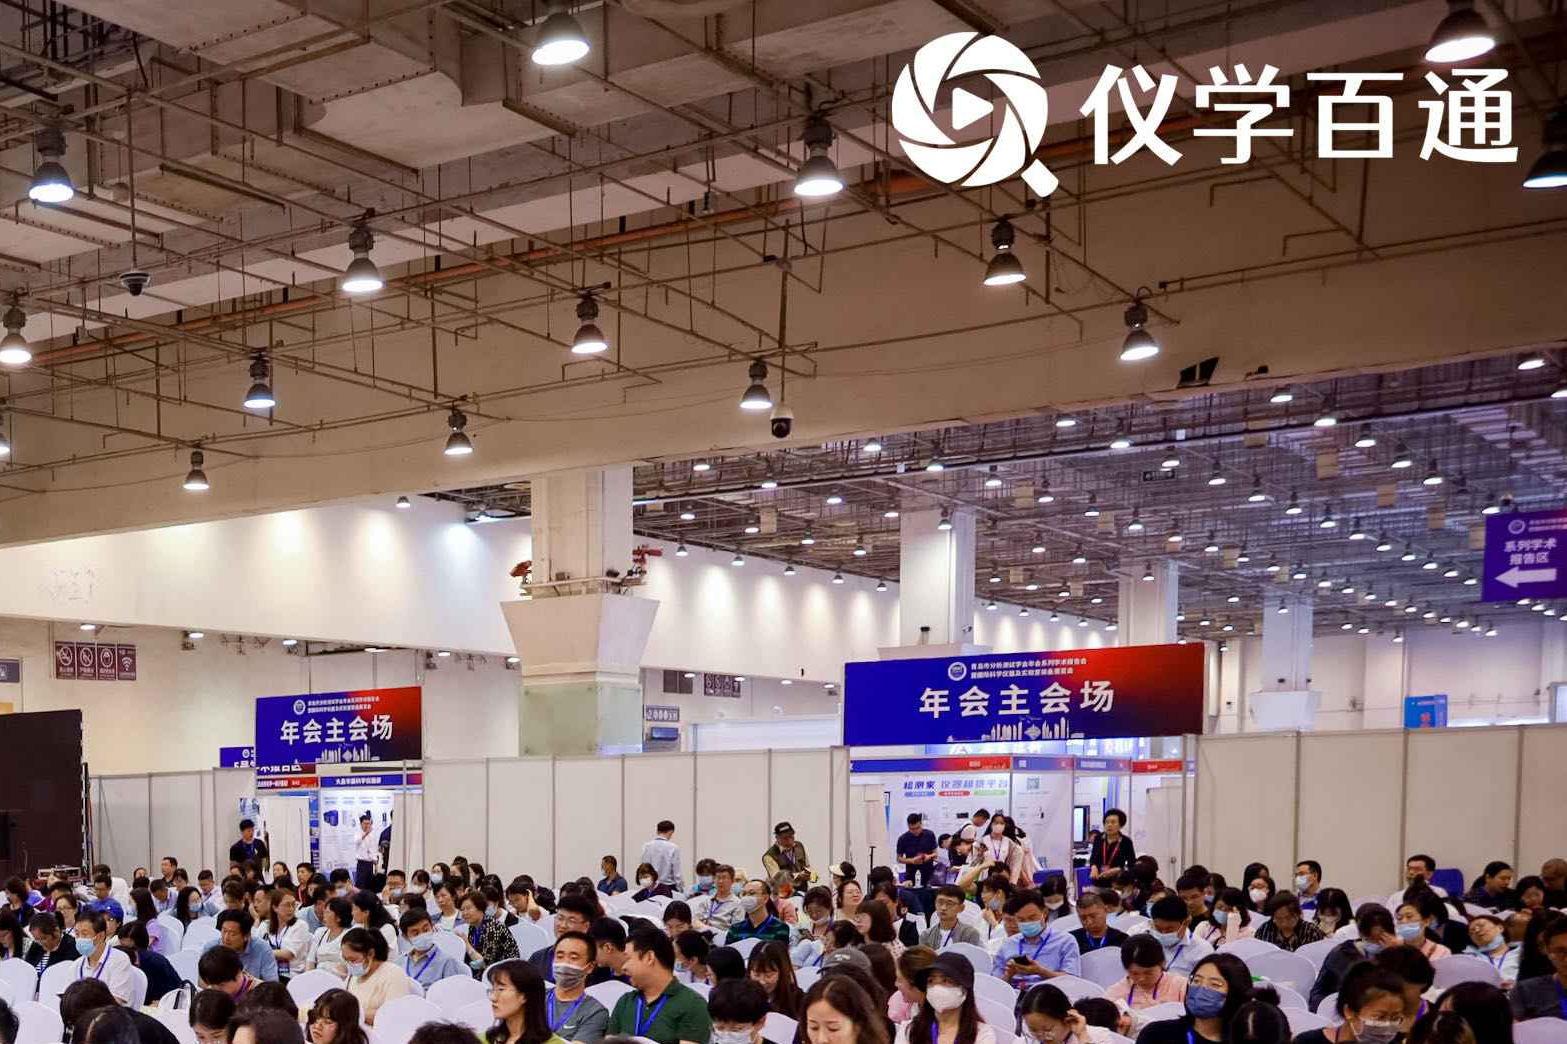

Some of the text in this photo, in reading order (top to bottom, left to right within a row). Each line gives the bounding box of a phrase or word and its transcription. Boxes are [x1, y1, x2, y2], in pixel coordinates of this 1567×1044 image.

[919, 680, 1115, 719] 年会主会场
[280, 714, 393, 745] 年会主会场
